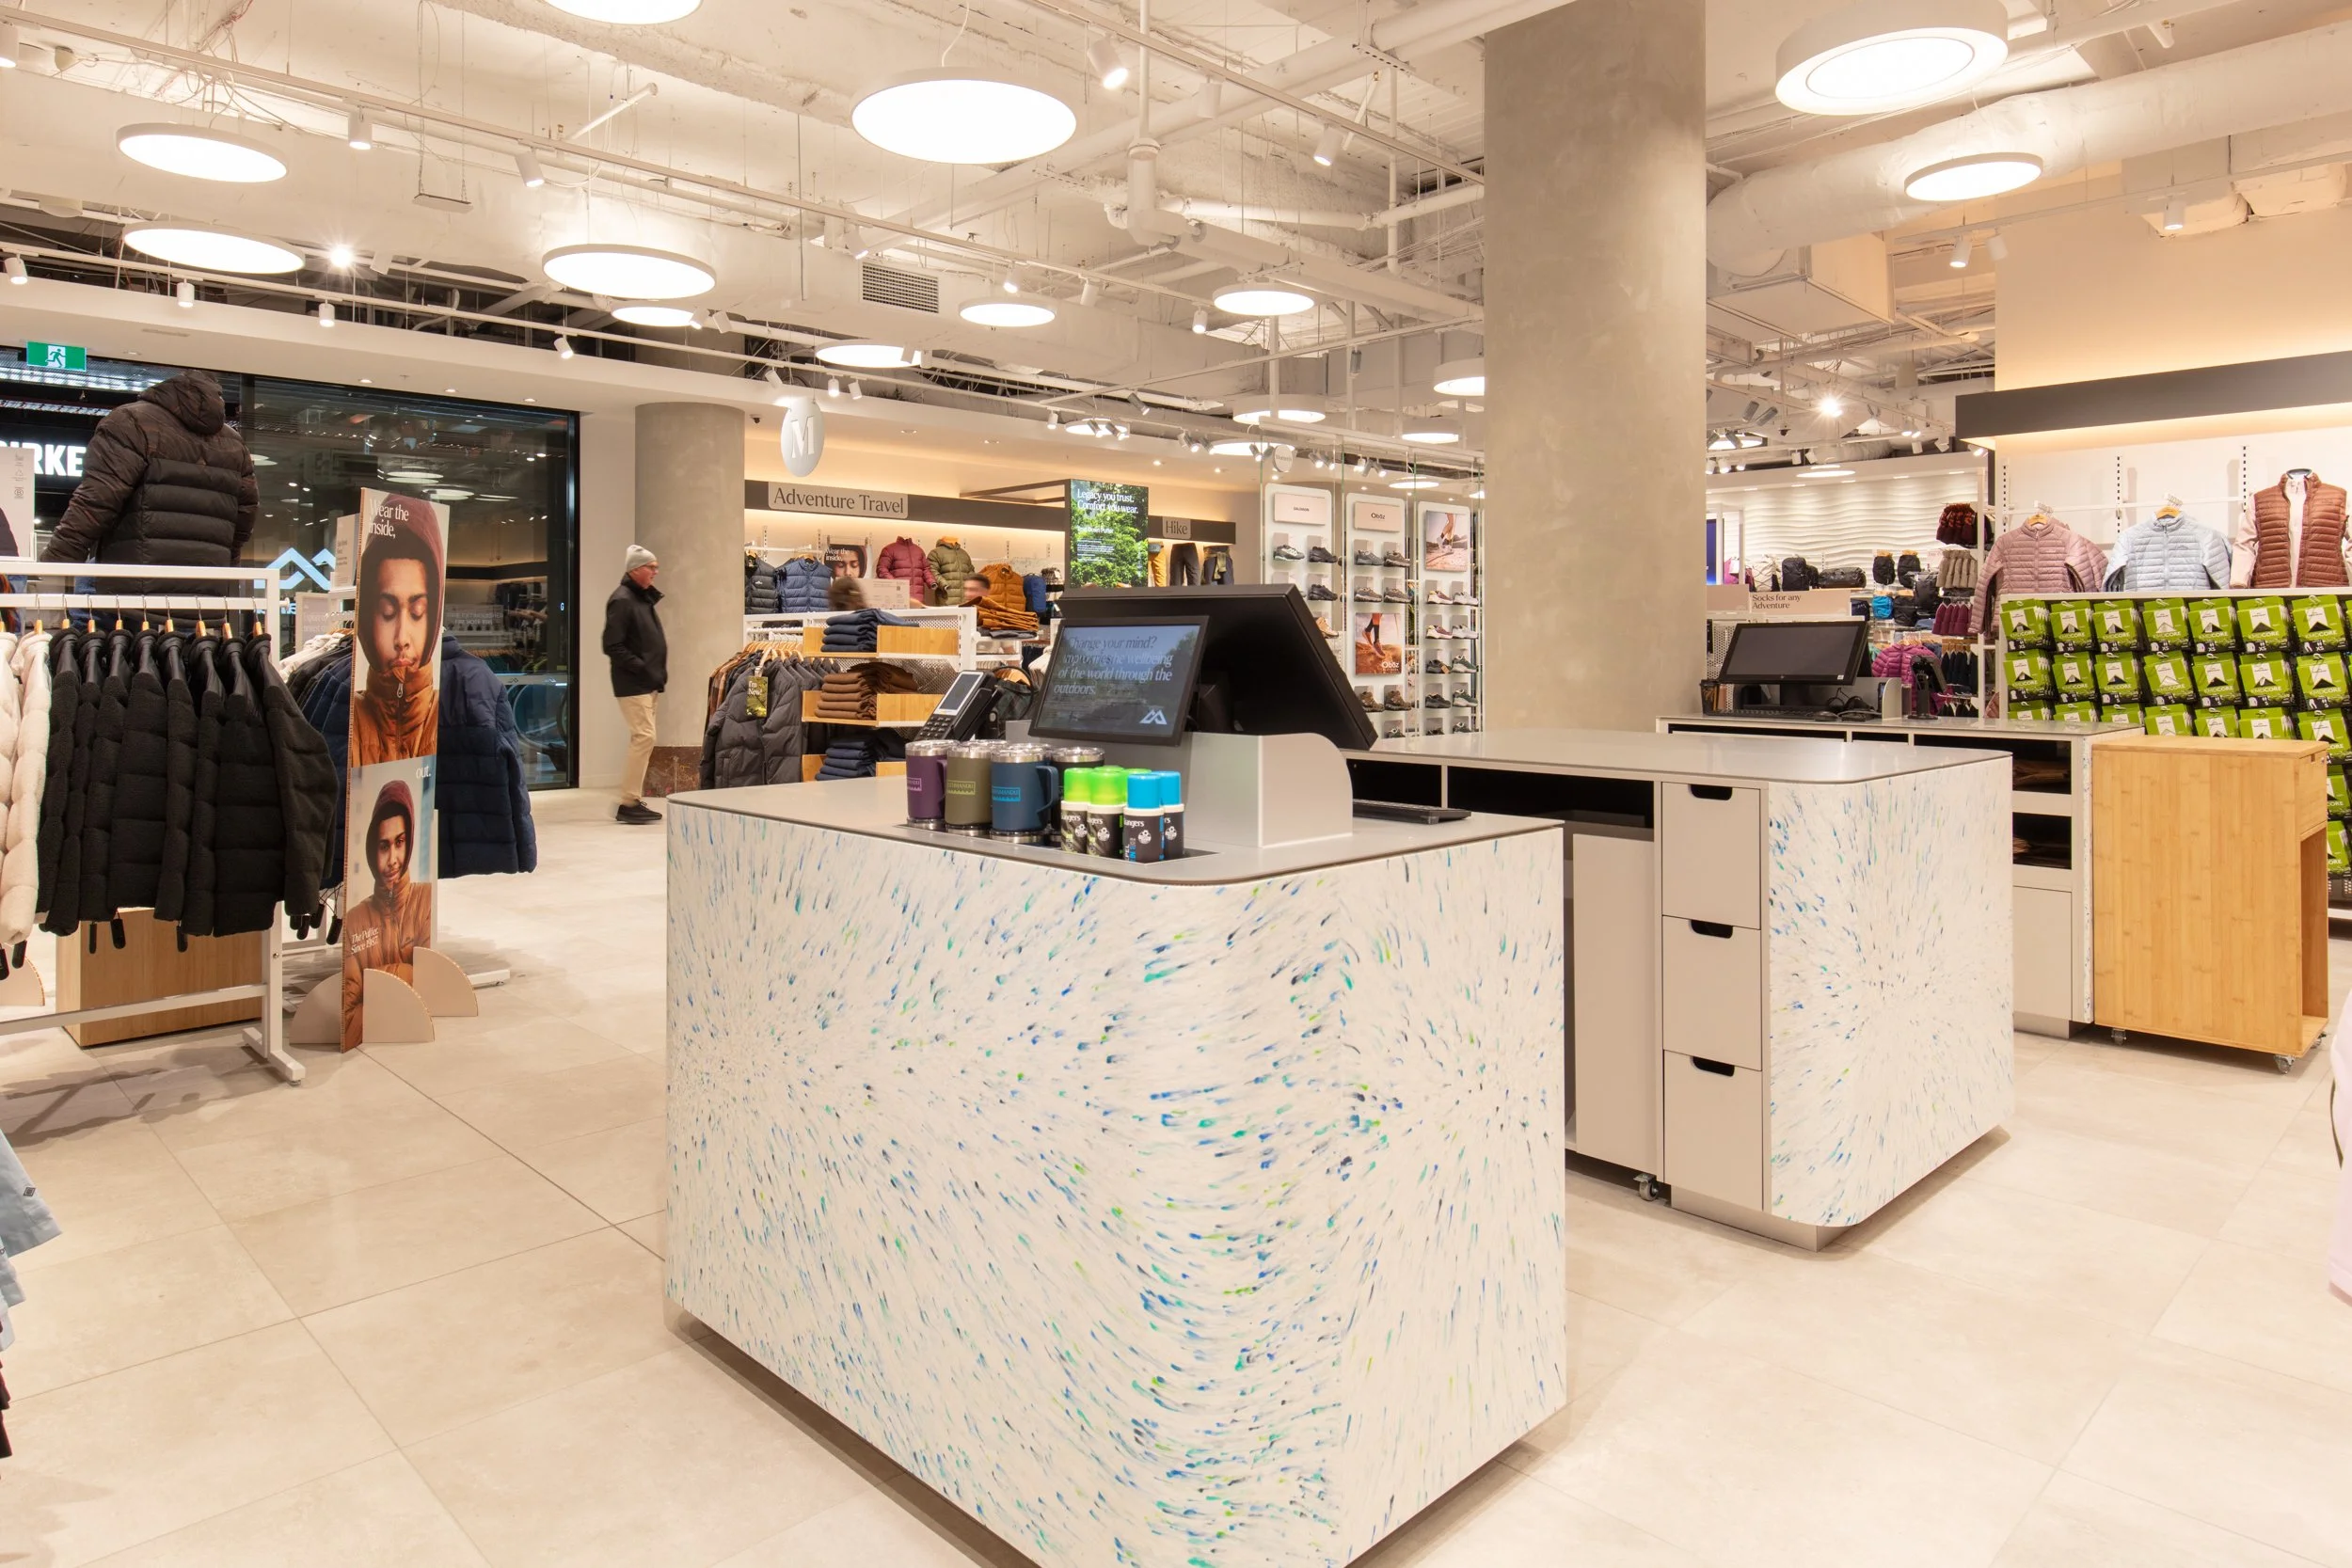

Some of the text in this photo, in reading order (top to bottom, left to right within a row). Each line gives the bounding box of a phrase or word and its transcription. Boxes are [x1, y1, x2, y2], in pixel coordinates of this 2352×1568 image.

[790, 415, 815, 459] M
[0, 439, 87, 478] RKE
[773, 487, 904, 514] Adventure Travel
[1077, 489, 1135, 503] Legacy you trust.
[370, 499, 409, 522] Wear the
[1077, 500, 1138, 514] Comfort you wear.
[370, 518, 396, 539] inside,
[1167, 520, 1188, 534] Hike
[1752, 594, 1774, 602] Socks
[1775, 594, 1787, 602] for
[1102, 639, 1123, 653] your
[1125, 636, 1157, 650] mind?
[1127, 653, 1173, 667] wellbeing
[1058, 667, 1173, 684] of the world through the
[1054, 683, 1096, 695] outdoors.
[416, 765, 432, 779] out.
[1061, 815, 1081, 823] angers
[1124, 818, 1145, 828] angers
[352, 933, 361, 944] The
[351, 943, 365, 955] Since
